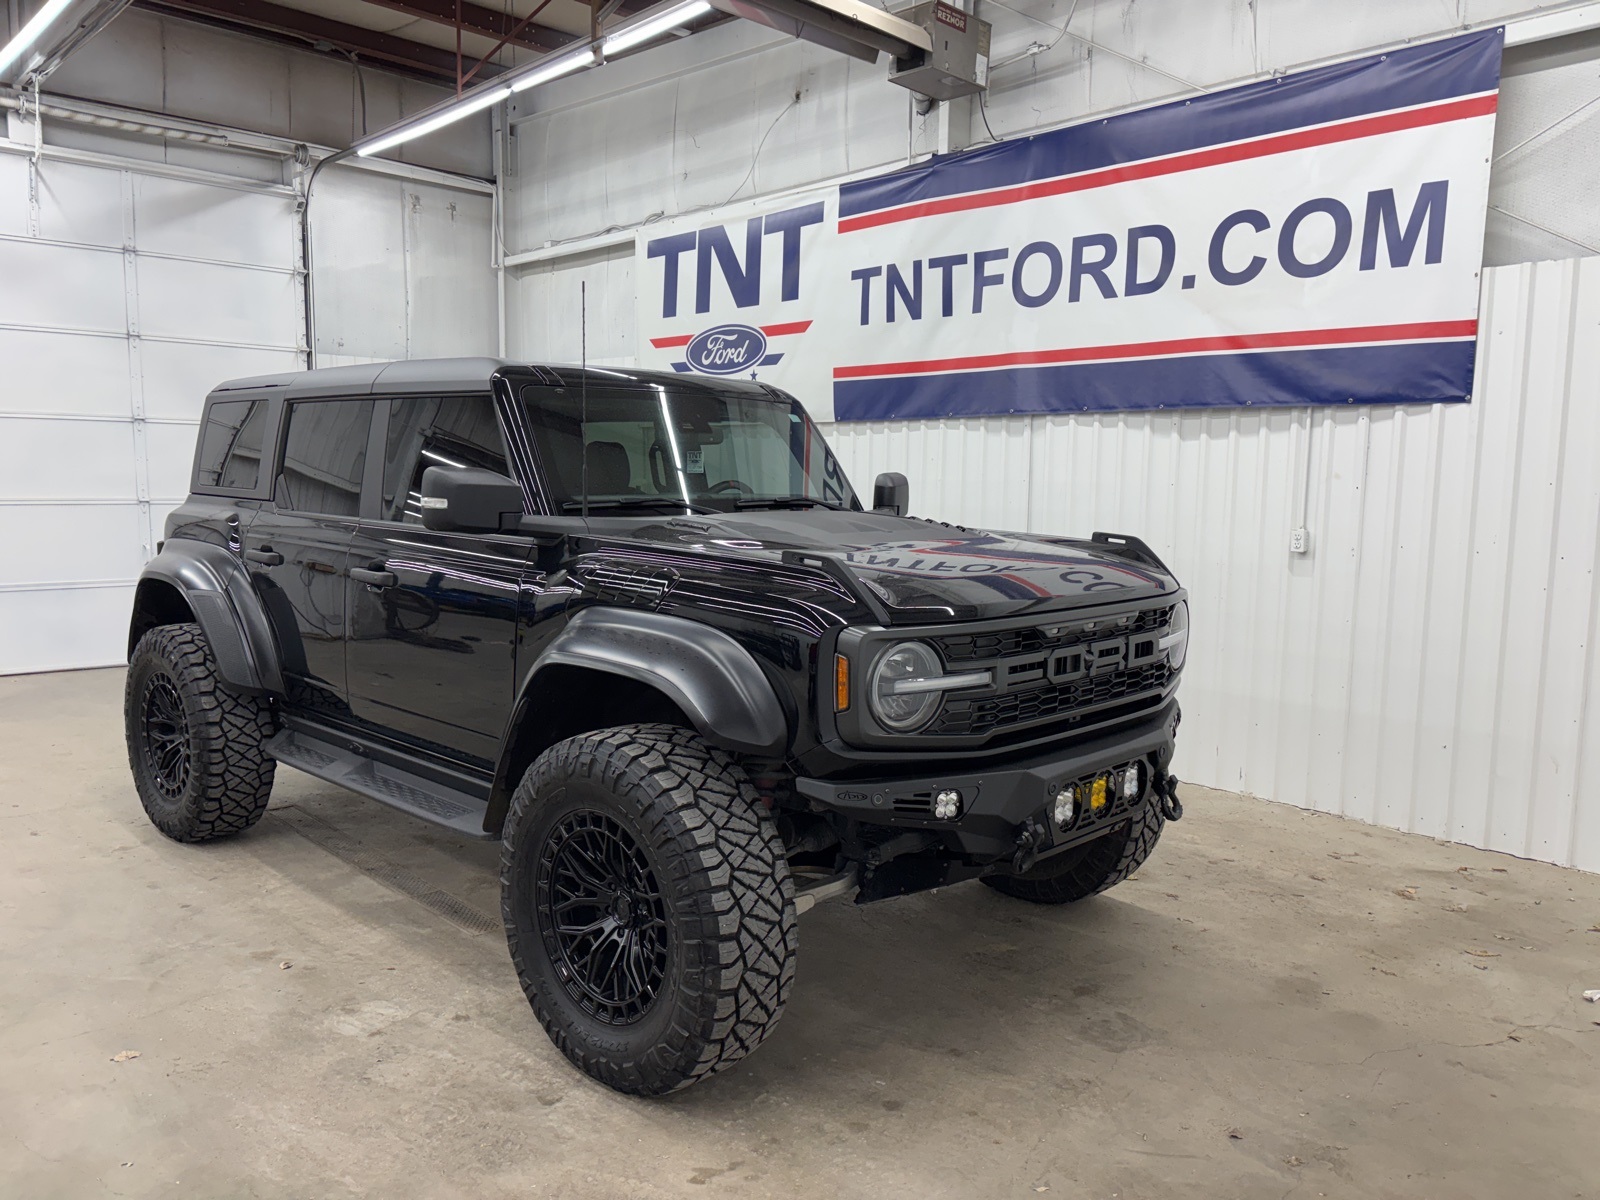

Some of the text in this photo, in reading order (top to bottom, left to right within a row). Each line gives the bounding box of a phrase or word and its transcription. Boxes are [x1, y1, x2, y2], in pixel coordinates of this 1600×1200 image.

[937, 9, 965, 29] REZNOR
[647, 200, 825, 319] TNT
[850, 179, 1450, 326] TNTFORD.COM
[701, 333, 750, 366] Ford
[997, 630, 1161, 696] FORD
